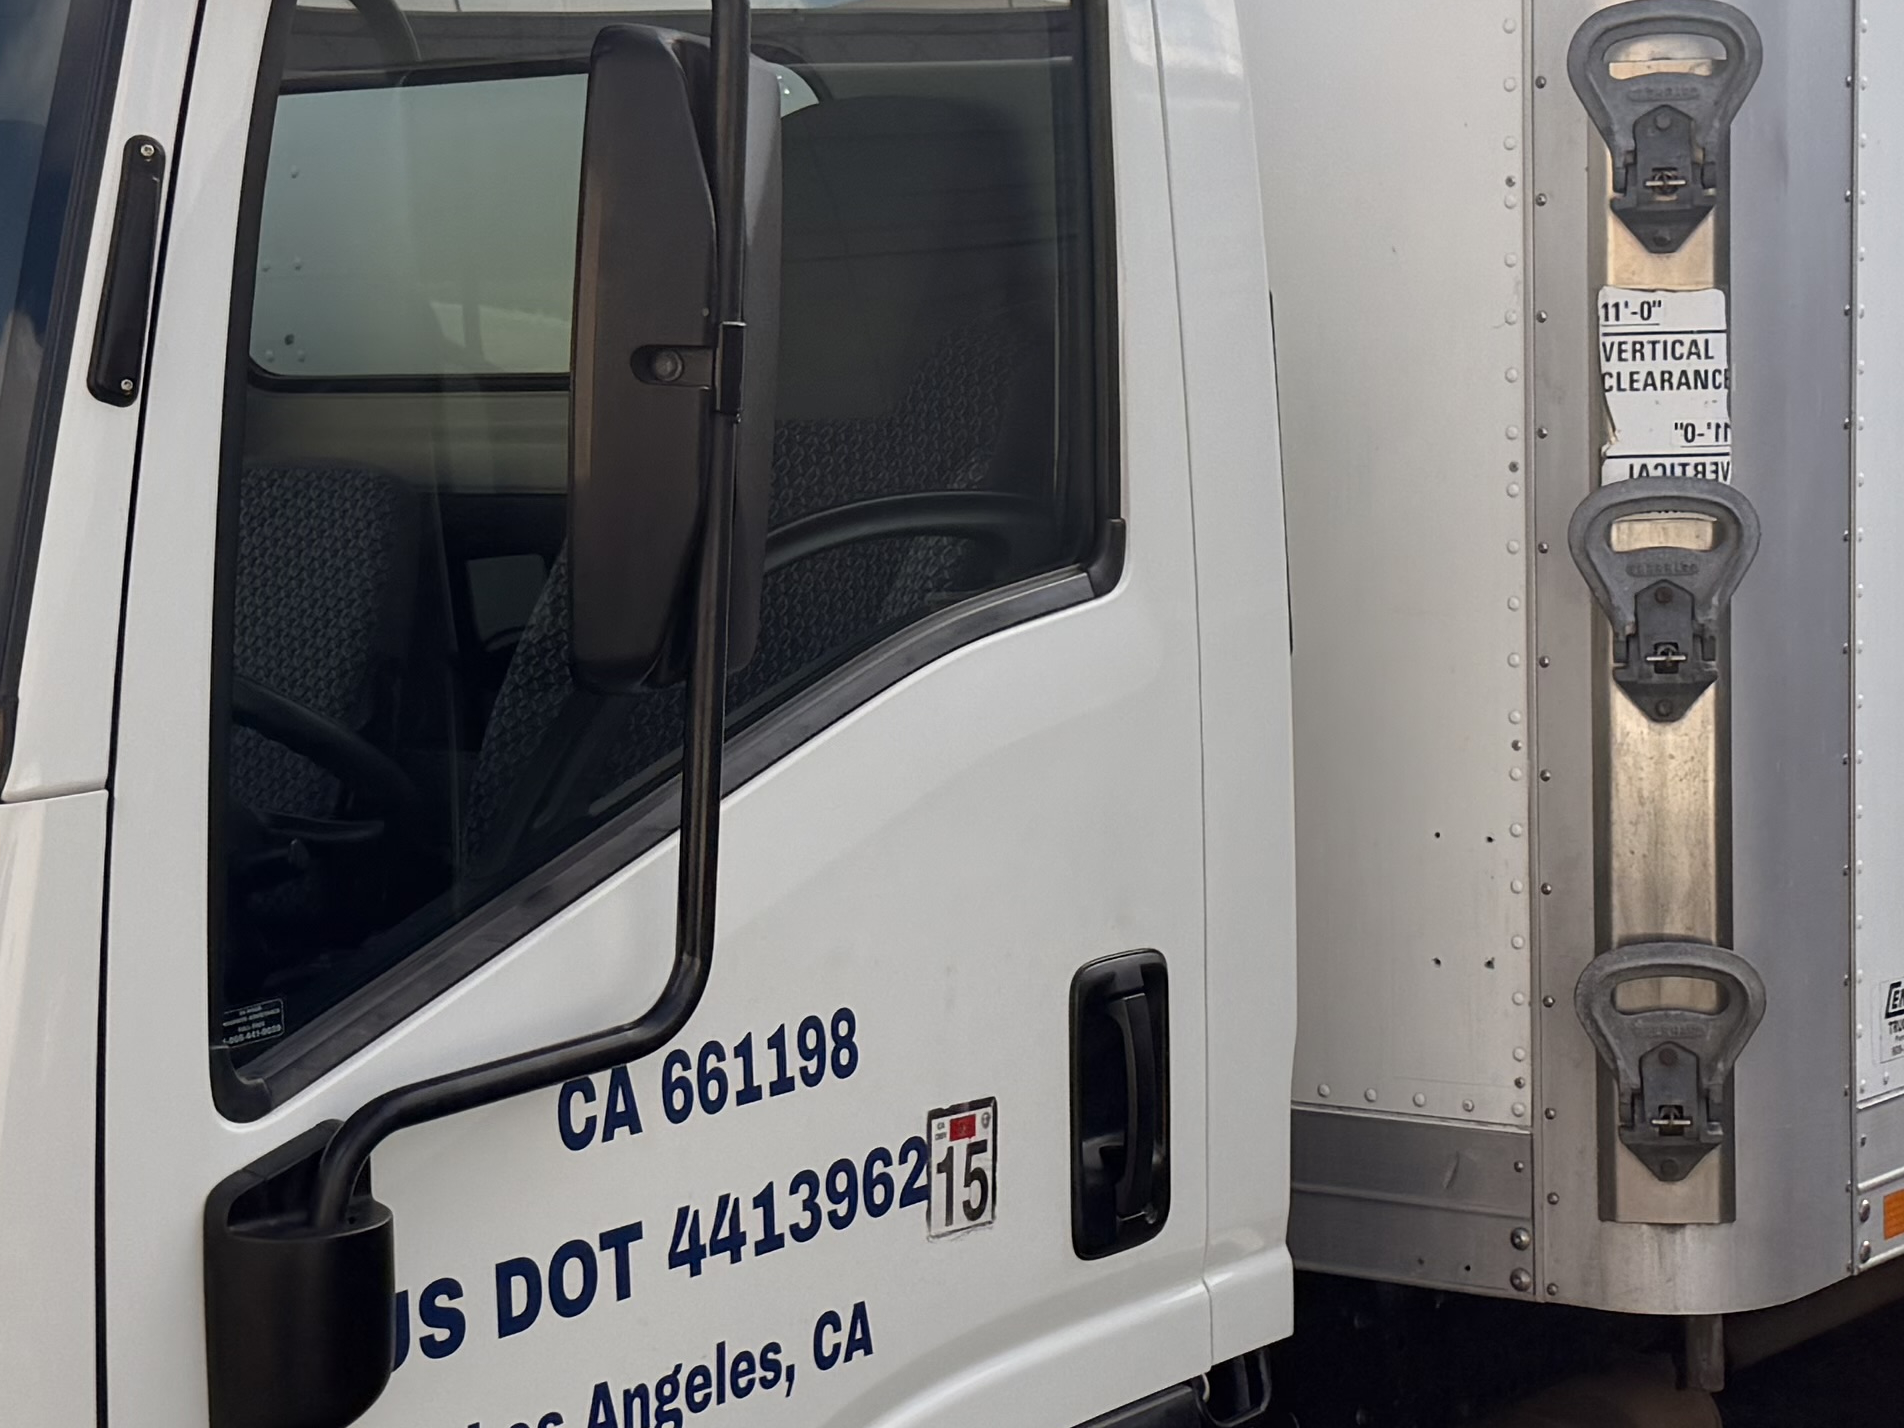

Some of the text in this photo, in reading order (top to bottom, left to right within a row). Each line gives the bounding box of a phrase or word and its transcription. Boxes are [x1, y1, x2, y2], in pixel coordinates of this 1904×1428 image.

[1600, 299, 1663, 323] 11'-0"
[1601, 338, 1715, 363] VERTICAL
[557, 1005, 860, 1153] CA 661198
[936, 1139, 989, 1227] 15
[496, 1221, 645, 1340] DOT
[667, 1135, 930, 1278] 4413962
[812, 1300, 875, 1372] CA
